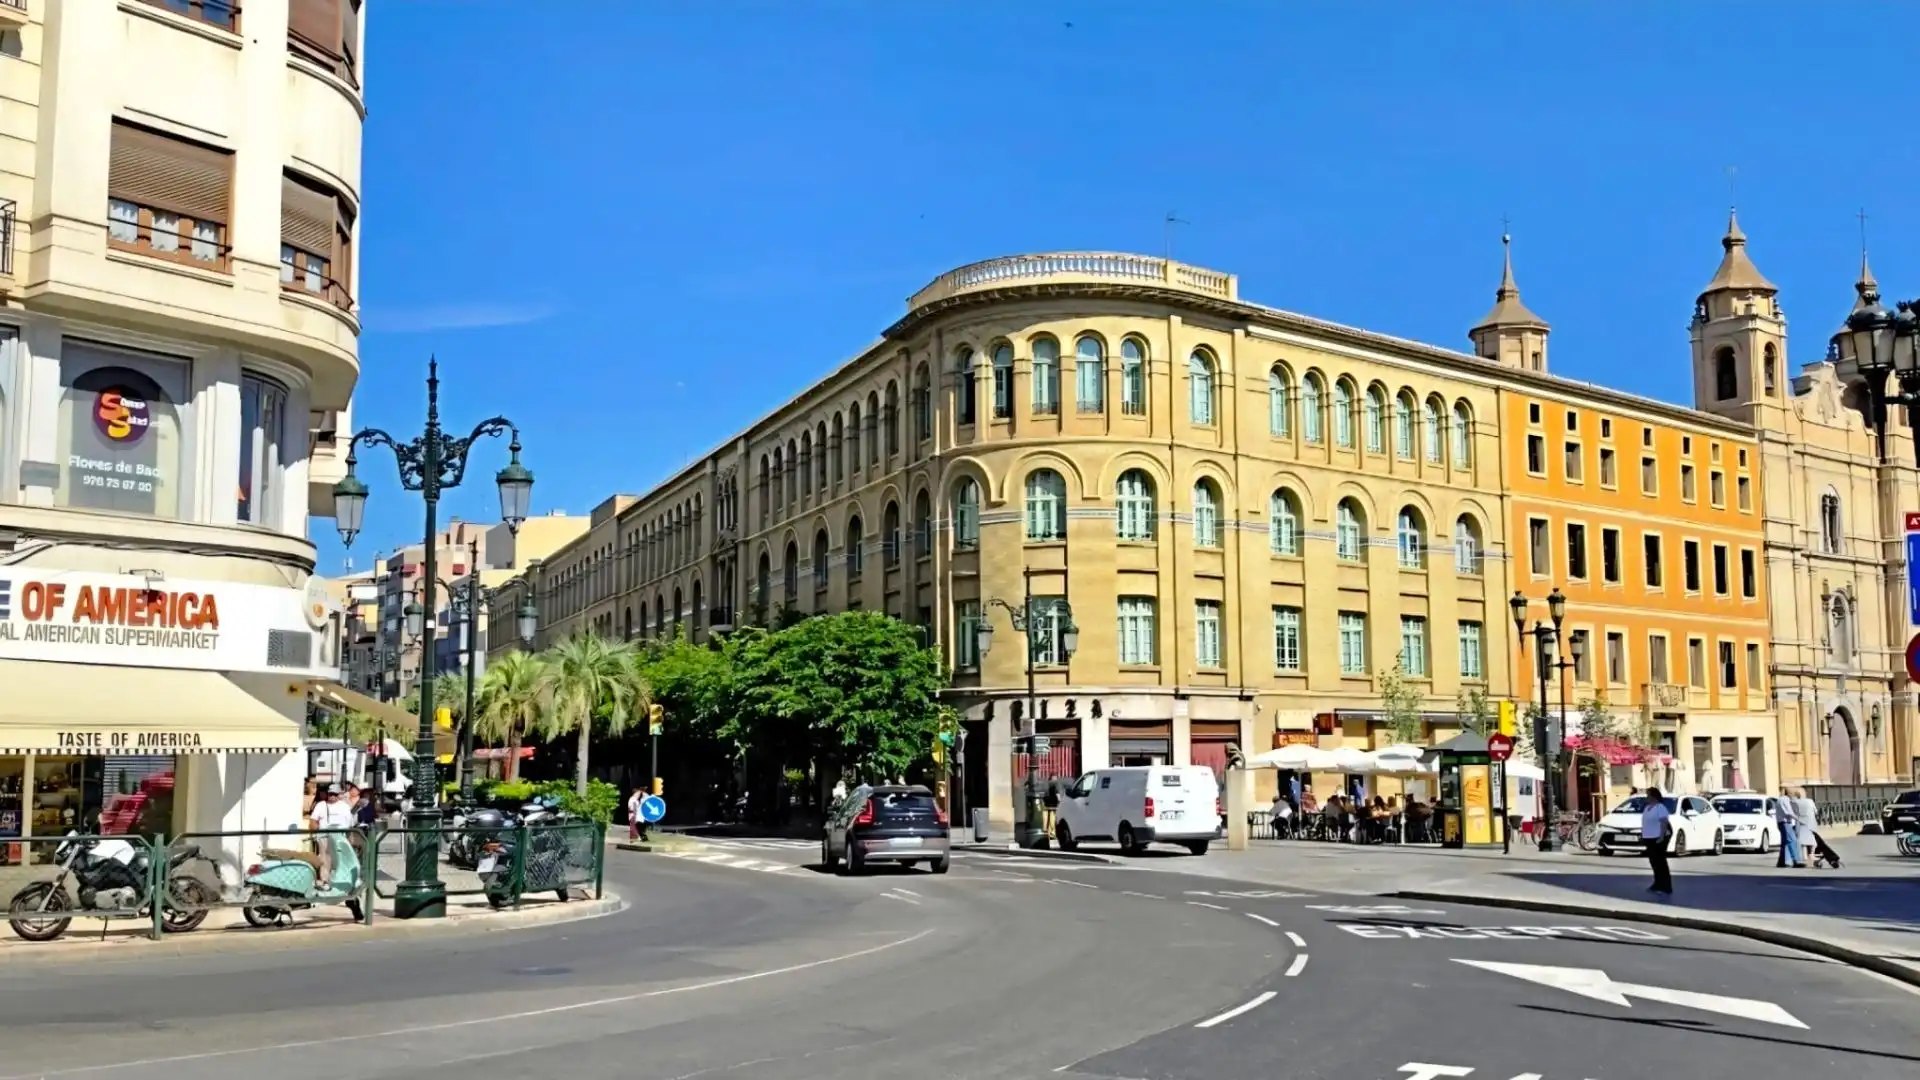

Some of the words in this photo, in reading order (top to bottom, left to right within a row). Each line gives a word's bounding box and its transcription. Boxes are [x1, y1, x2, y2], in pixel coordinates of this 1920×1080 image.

[69, 455, 113, 472] Flores
[115, 460, 133, 474] de
[21, 581, 66, 621] OF
[73, 585, 219, 630] AMERICA
[24, 623, 100, 645] AMERICAN
[105, 627, 220, 650] SUPERMARKET
[57, 732, 102, 747] TASTE
[111, 732, 129, 747] OF
[138, 732, 201, 747] AMERICA
